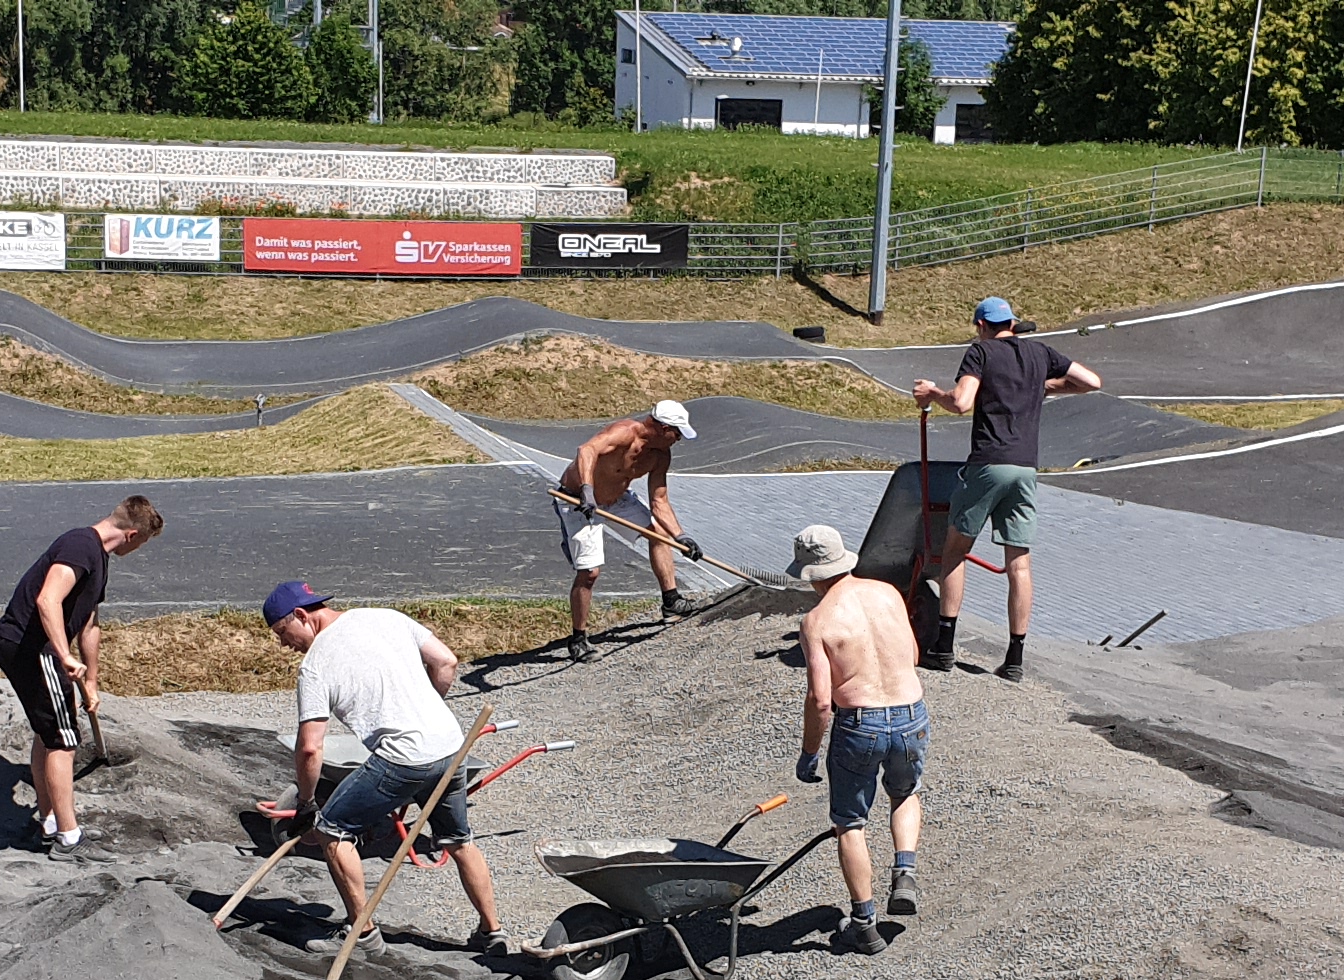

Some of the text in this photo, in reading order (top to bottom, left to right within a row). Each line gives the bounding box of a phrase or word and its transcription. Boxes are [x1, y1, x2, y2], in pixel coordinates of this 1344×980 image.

[133, 216, 213, 239] KURZ
[15, 243, 24, 251] IN
[27, 243, 60, 251] KASSEL
[255, 236, 362, 251] Damit was passiert,
[448, 241, 512, 253] Sparkassen
[255, 249, 359, 263] wenn was passiert.
[442, 252, 512, 266] Versicherung
